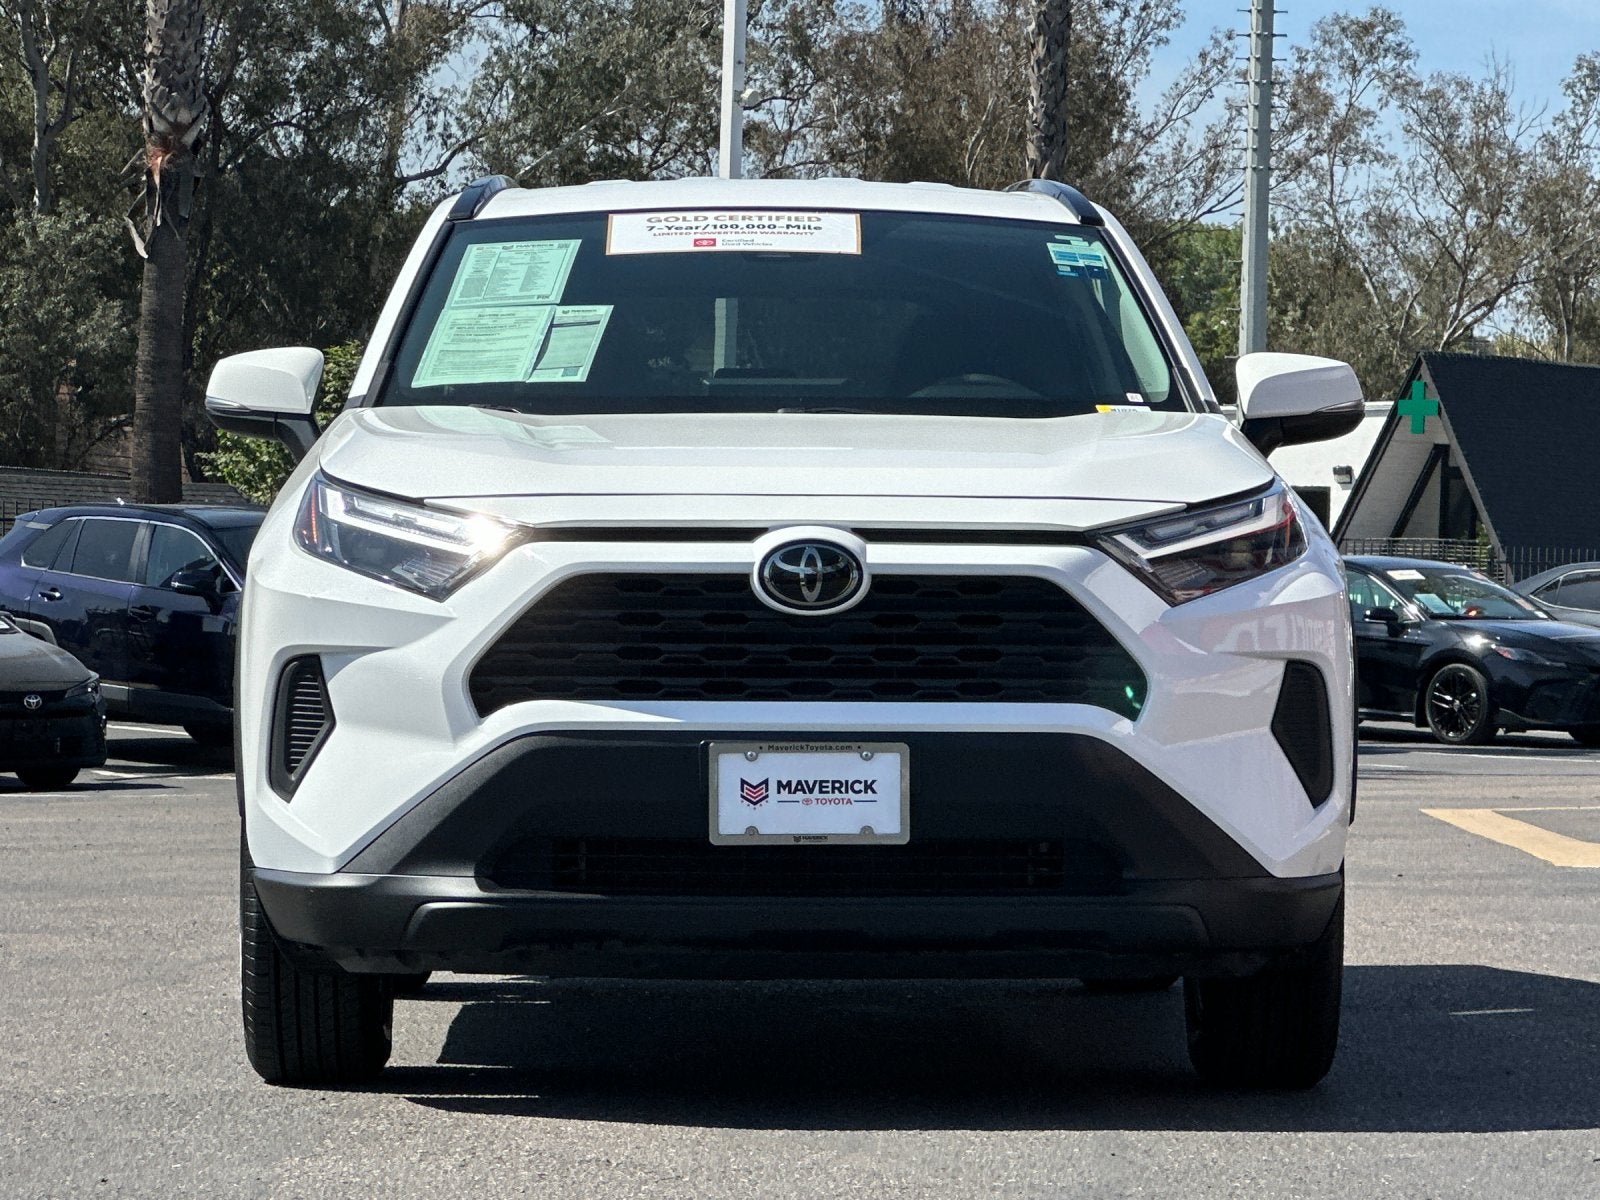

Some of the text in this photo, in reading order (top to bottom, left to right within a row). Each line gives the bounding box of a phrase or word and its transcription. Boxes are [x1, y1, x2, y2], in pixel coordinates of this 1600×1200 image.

[646, 214, 822, 223] GOLD CERTIFIED
[767, 744, 853, 752] MaverickToyota.com
[776, 779, 878, 795] MAVERICK
[814, 797, 853, 806] TOYOTA
